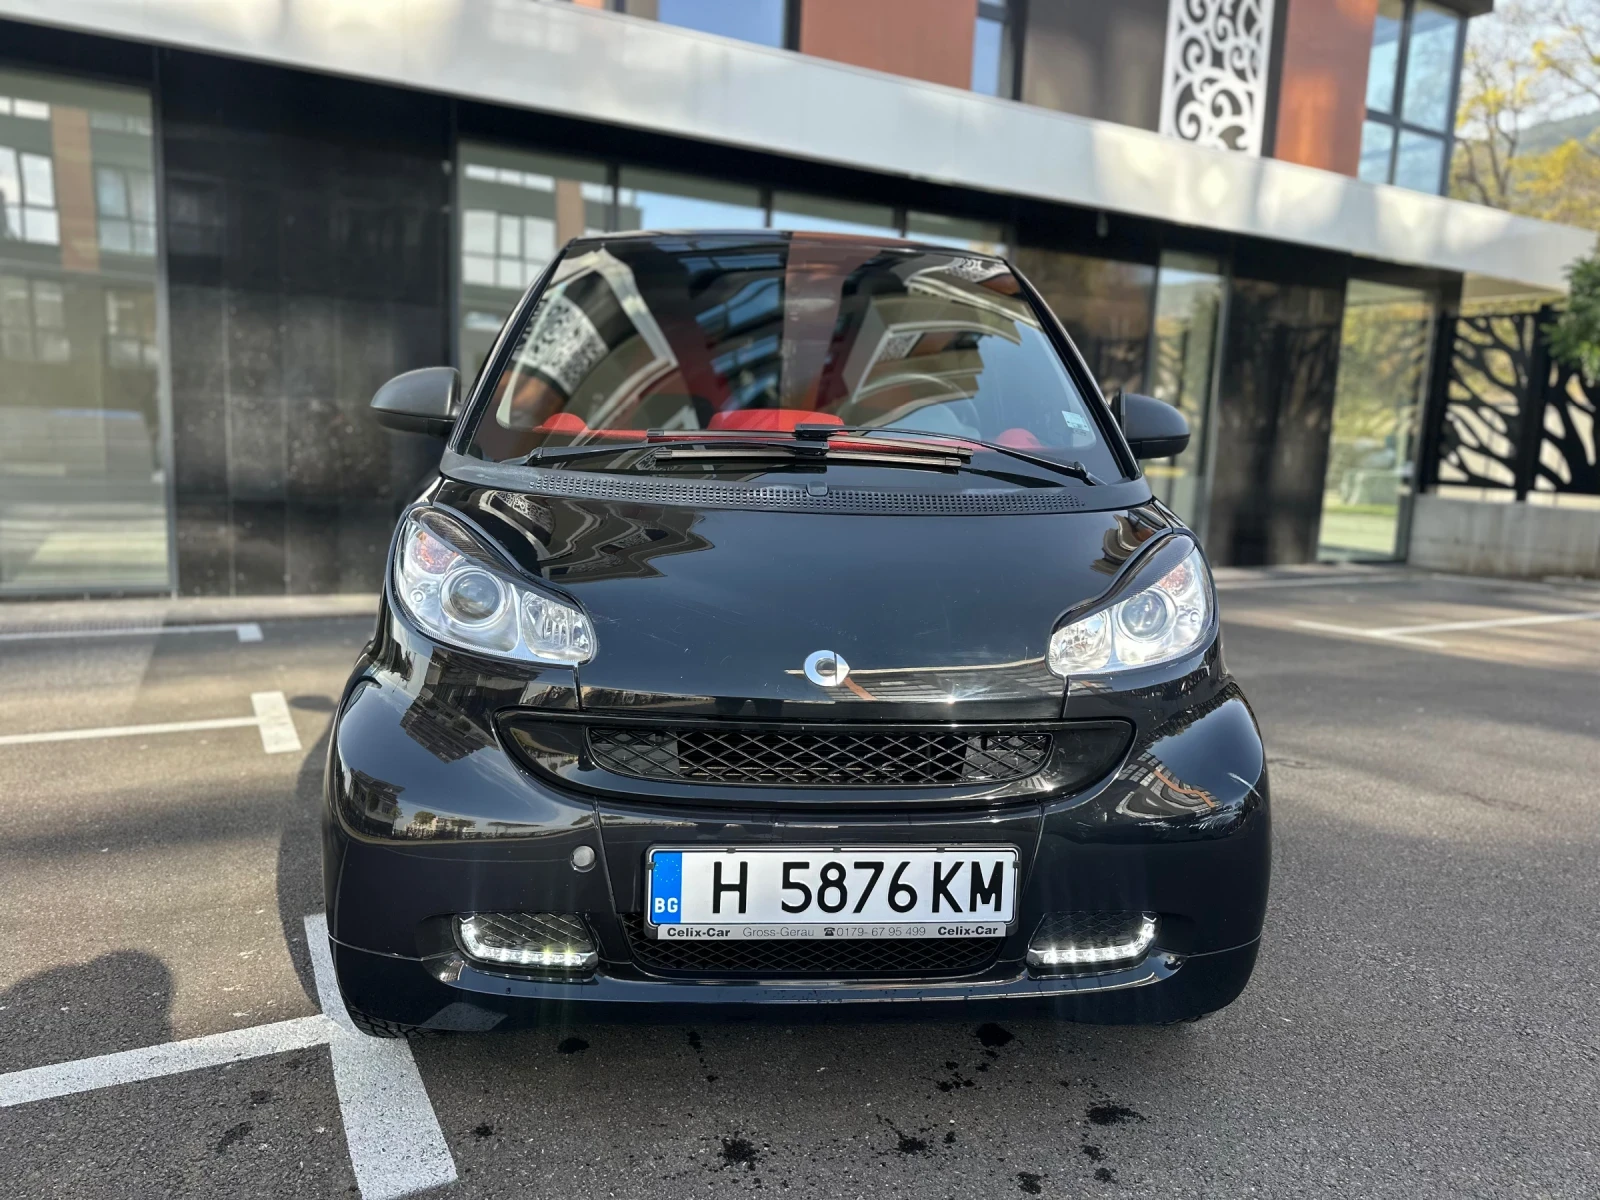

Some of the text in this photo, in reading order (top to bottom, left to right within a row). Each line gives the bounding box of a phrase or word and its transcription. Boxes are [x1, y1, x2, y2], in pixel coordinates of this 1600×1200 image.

[711, 861, 1004, 914] H 5876 KM
[654, 897, 679, 913] BG
[667, 927, 731, 937] Celix-Car
[742, 927, 815, 937] Gross-Gerau
[871, 927, 885, 936] 67
[888, 927, 902, 936] 95
[905, 926, 926, 936] 499
[937, 926, 998, 936] Celix-Car
